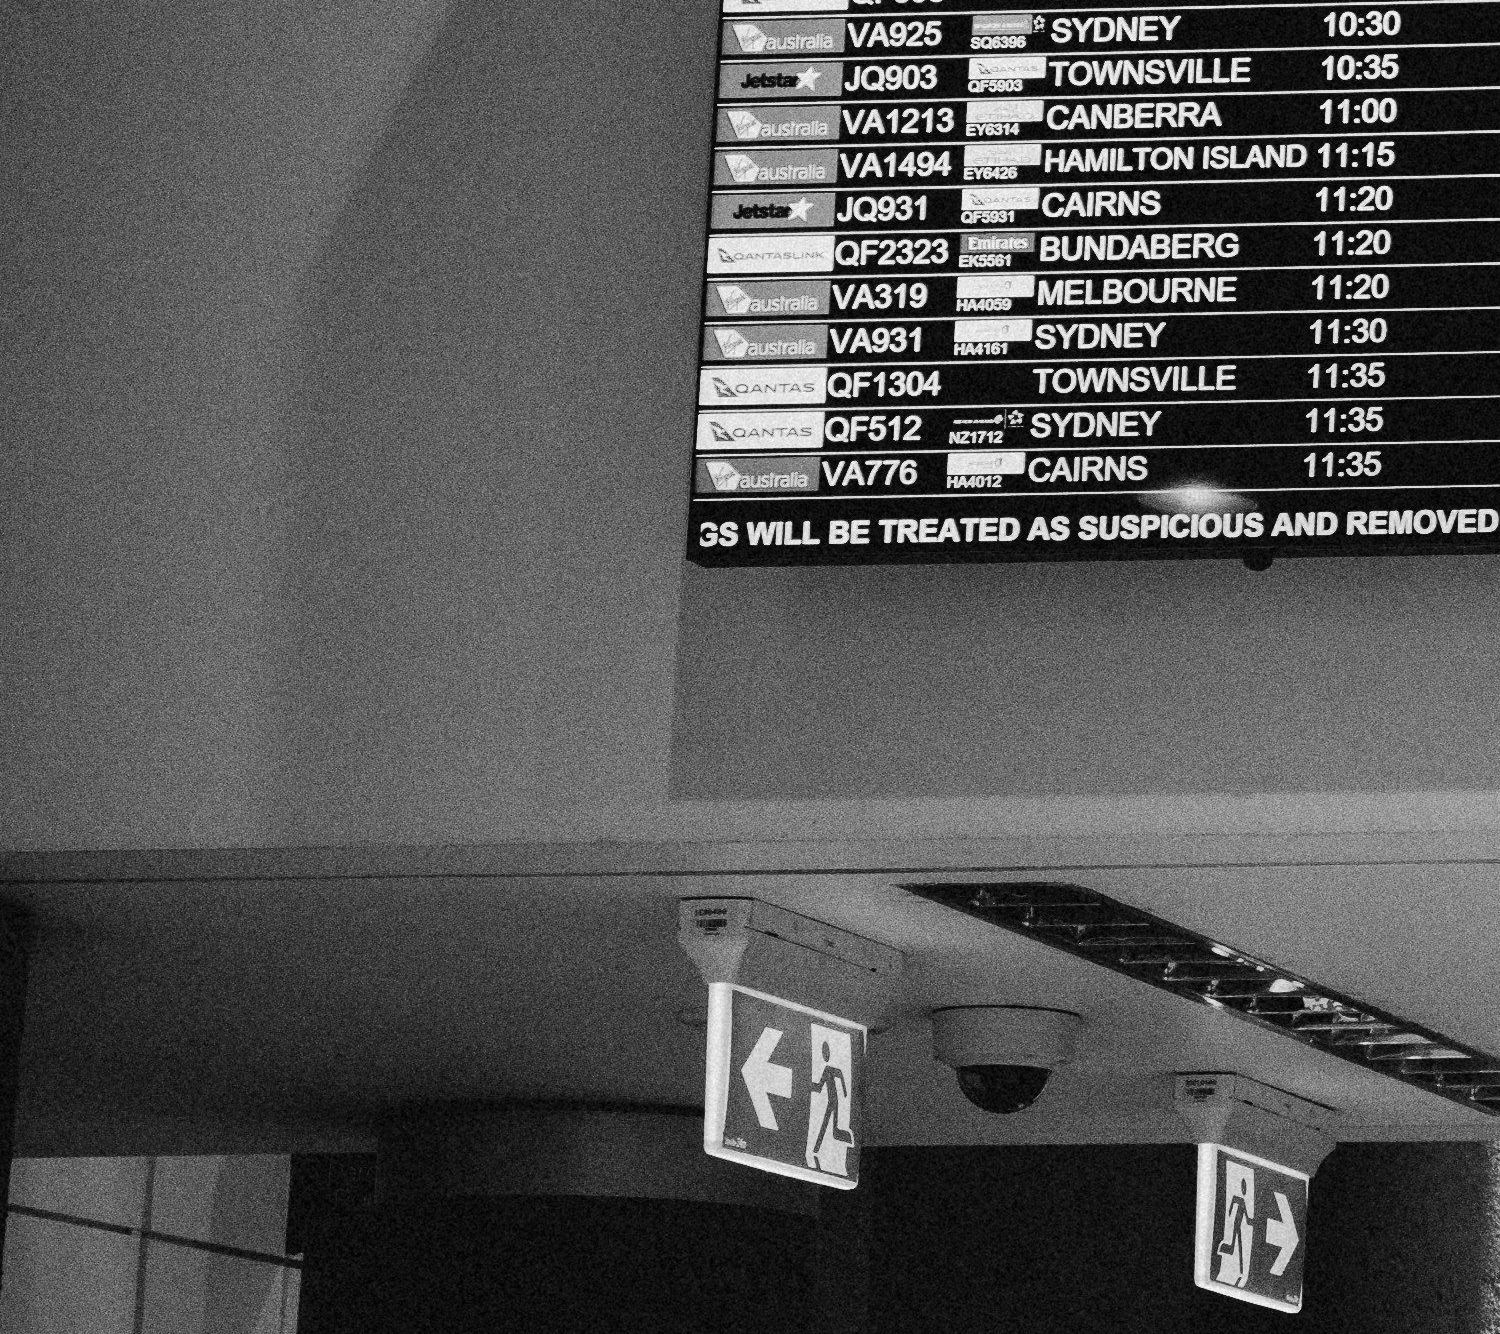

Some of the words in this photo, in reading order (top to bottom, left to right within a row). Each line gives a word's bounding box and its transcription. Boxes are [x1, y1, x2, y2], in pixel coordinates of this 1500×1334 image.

[840, 151, 952, 178] VA1494
[964, 167, 1017, 181] EY6426
[1045, 146, 1194, 173] HAMILTON
[1203, 144, 1307, 169] ISLAND
[1318, 141, 1395, 168] 11:15
[835, 239, 949, 266] QF2323
[959, 254, 1011, 267] EK5561
[1040, 233, 1239, 261] BUNDABERG
[1314, 229, 1391, 256] 11:20
[747, 521, 820, 545] WILL
[829, 520, 870, 544] BE
[878, 517, 1020, 543] TREATED
[1027, 516, 1070, 541] AS
[1078, 513, 1264, 540] SUSPICIOUS
[1271, 512, 1338, 536] AND
[1346, 509, 1499, 535] REMOVED
